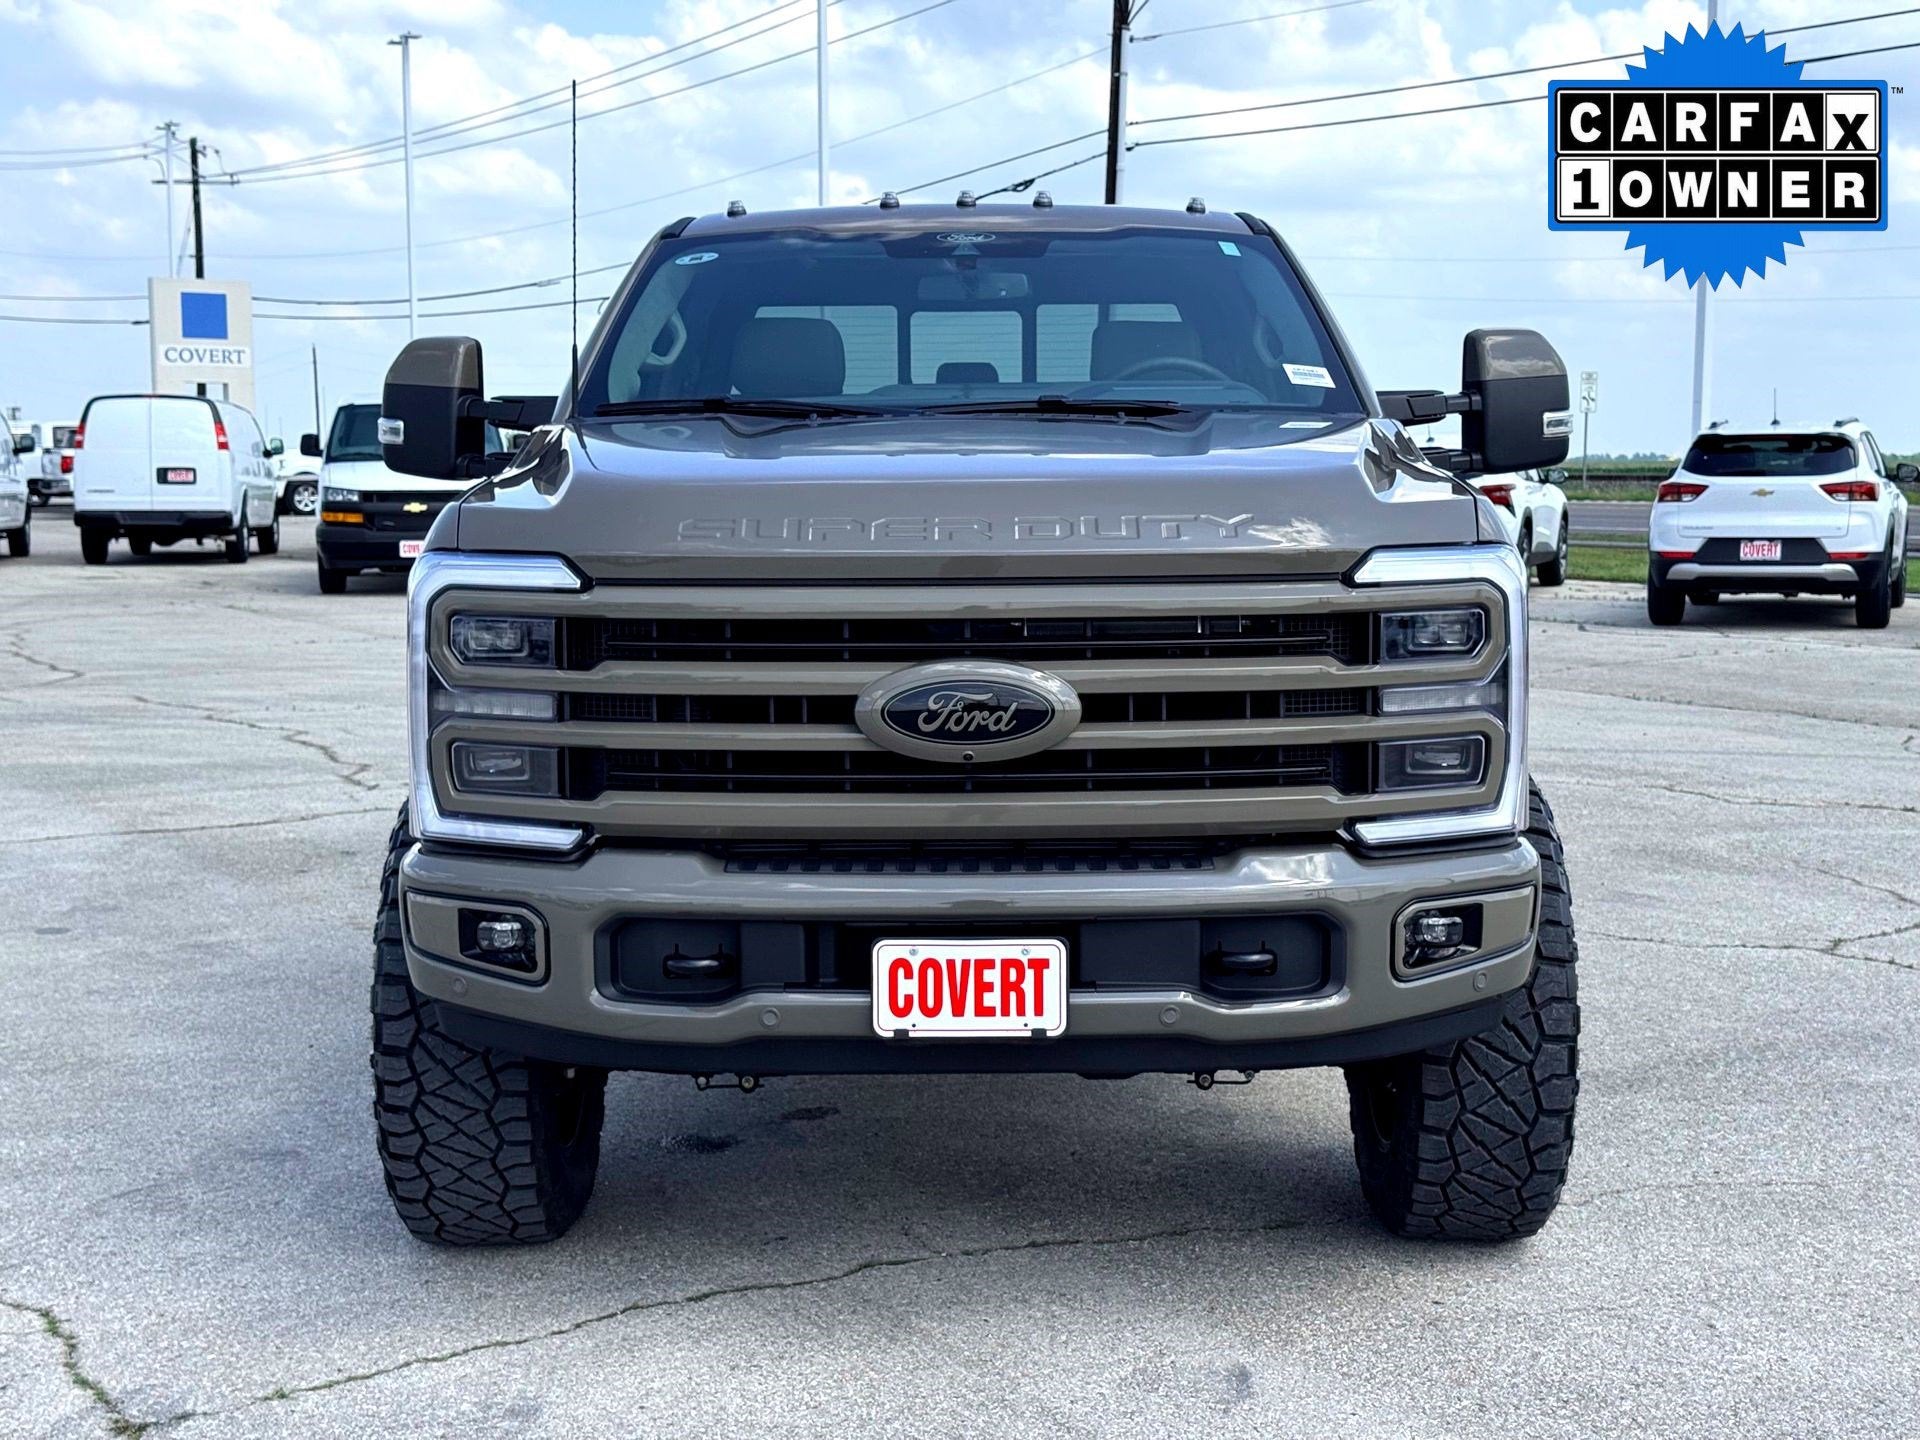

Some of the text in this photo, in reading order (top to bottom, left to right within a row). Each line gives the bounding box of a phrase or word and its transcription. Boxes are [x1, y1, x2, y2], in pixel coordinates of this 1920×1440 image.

[164, 346, 247, 364] COVERT
[677, 513, 1254, 541] SUPER DUTY
[1742, 543, 1779, 556] COVERT
[917, 691, 1018, 732] Ford
[888, 957, 1050, 1018] COVERT
